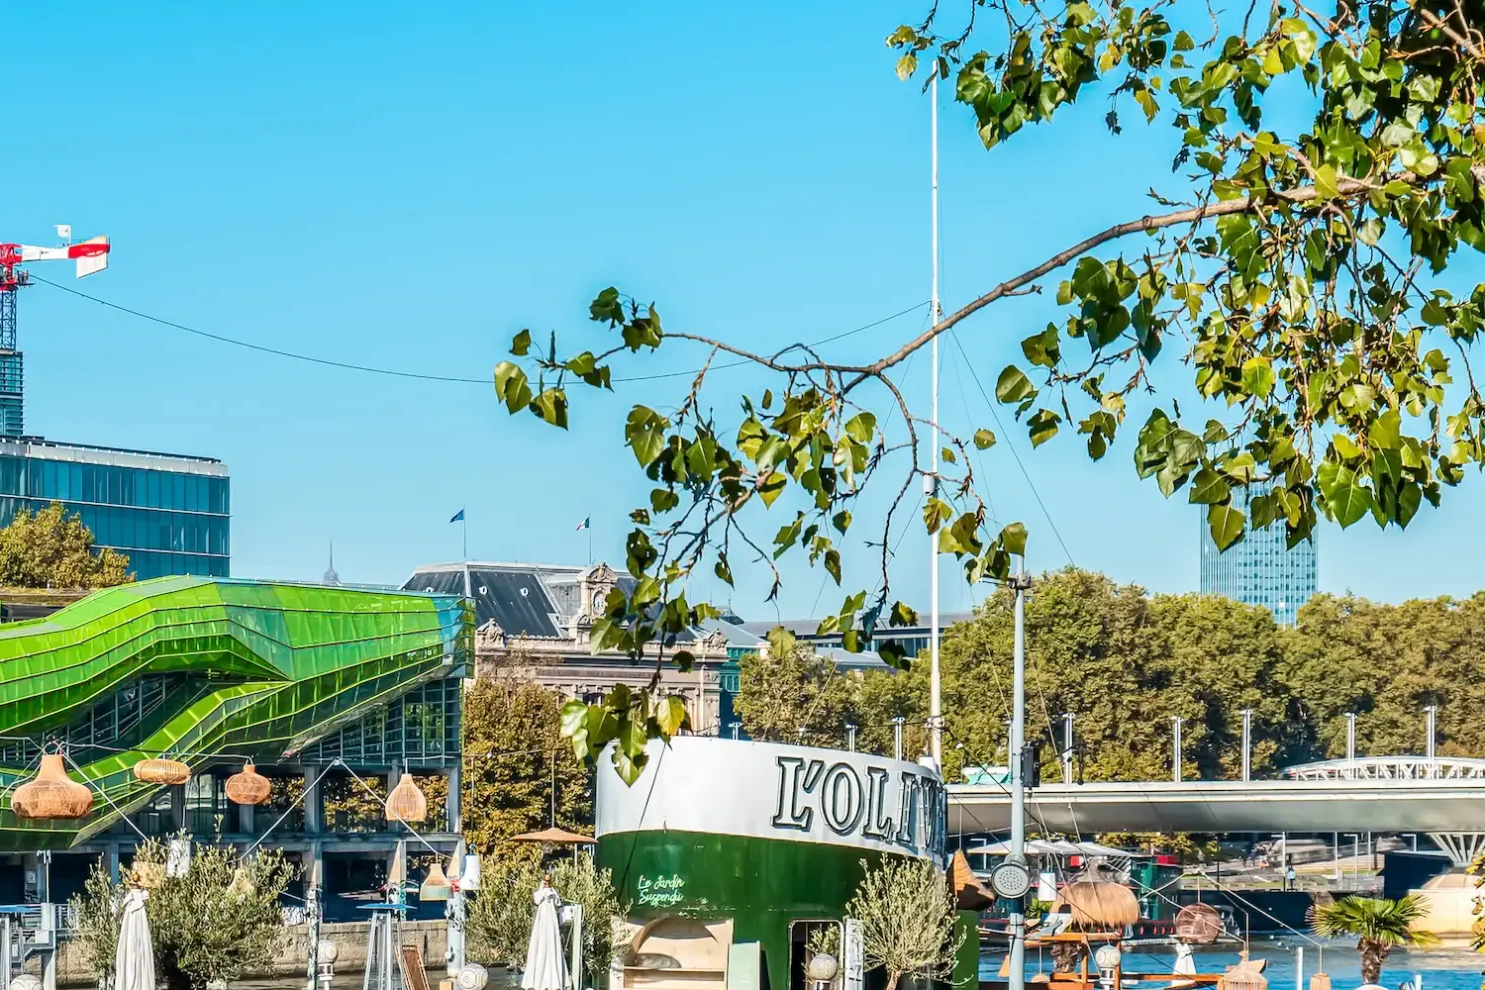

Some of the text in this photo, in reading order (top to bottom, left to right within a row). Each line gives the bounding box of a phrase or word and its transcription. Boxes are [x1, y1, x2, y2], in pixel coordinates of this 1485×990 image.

[637, 874, 685, 890] Le Jardin
[638, 888, 684, 906] Suspendu
